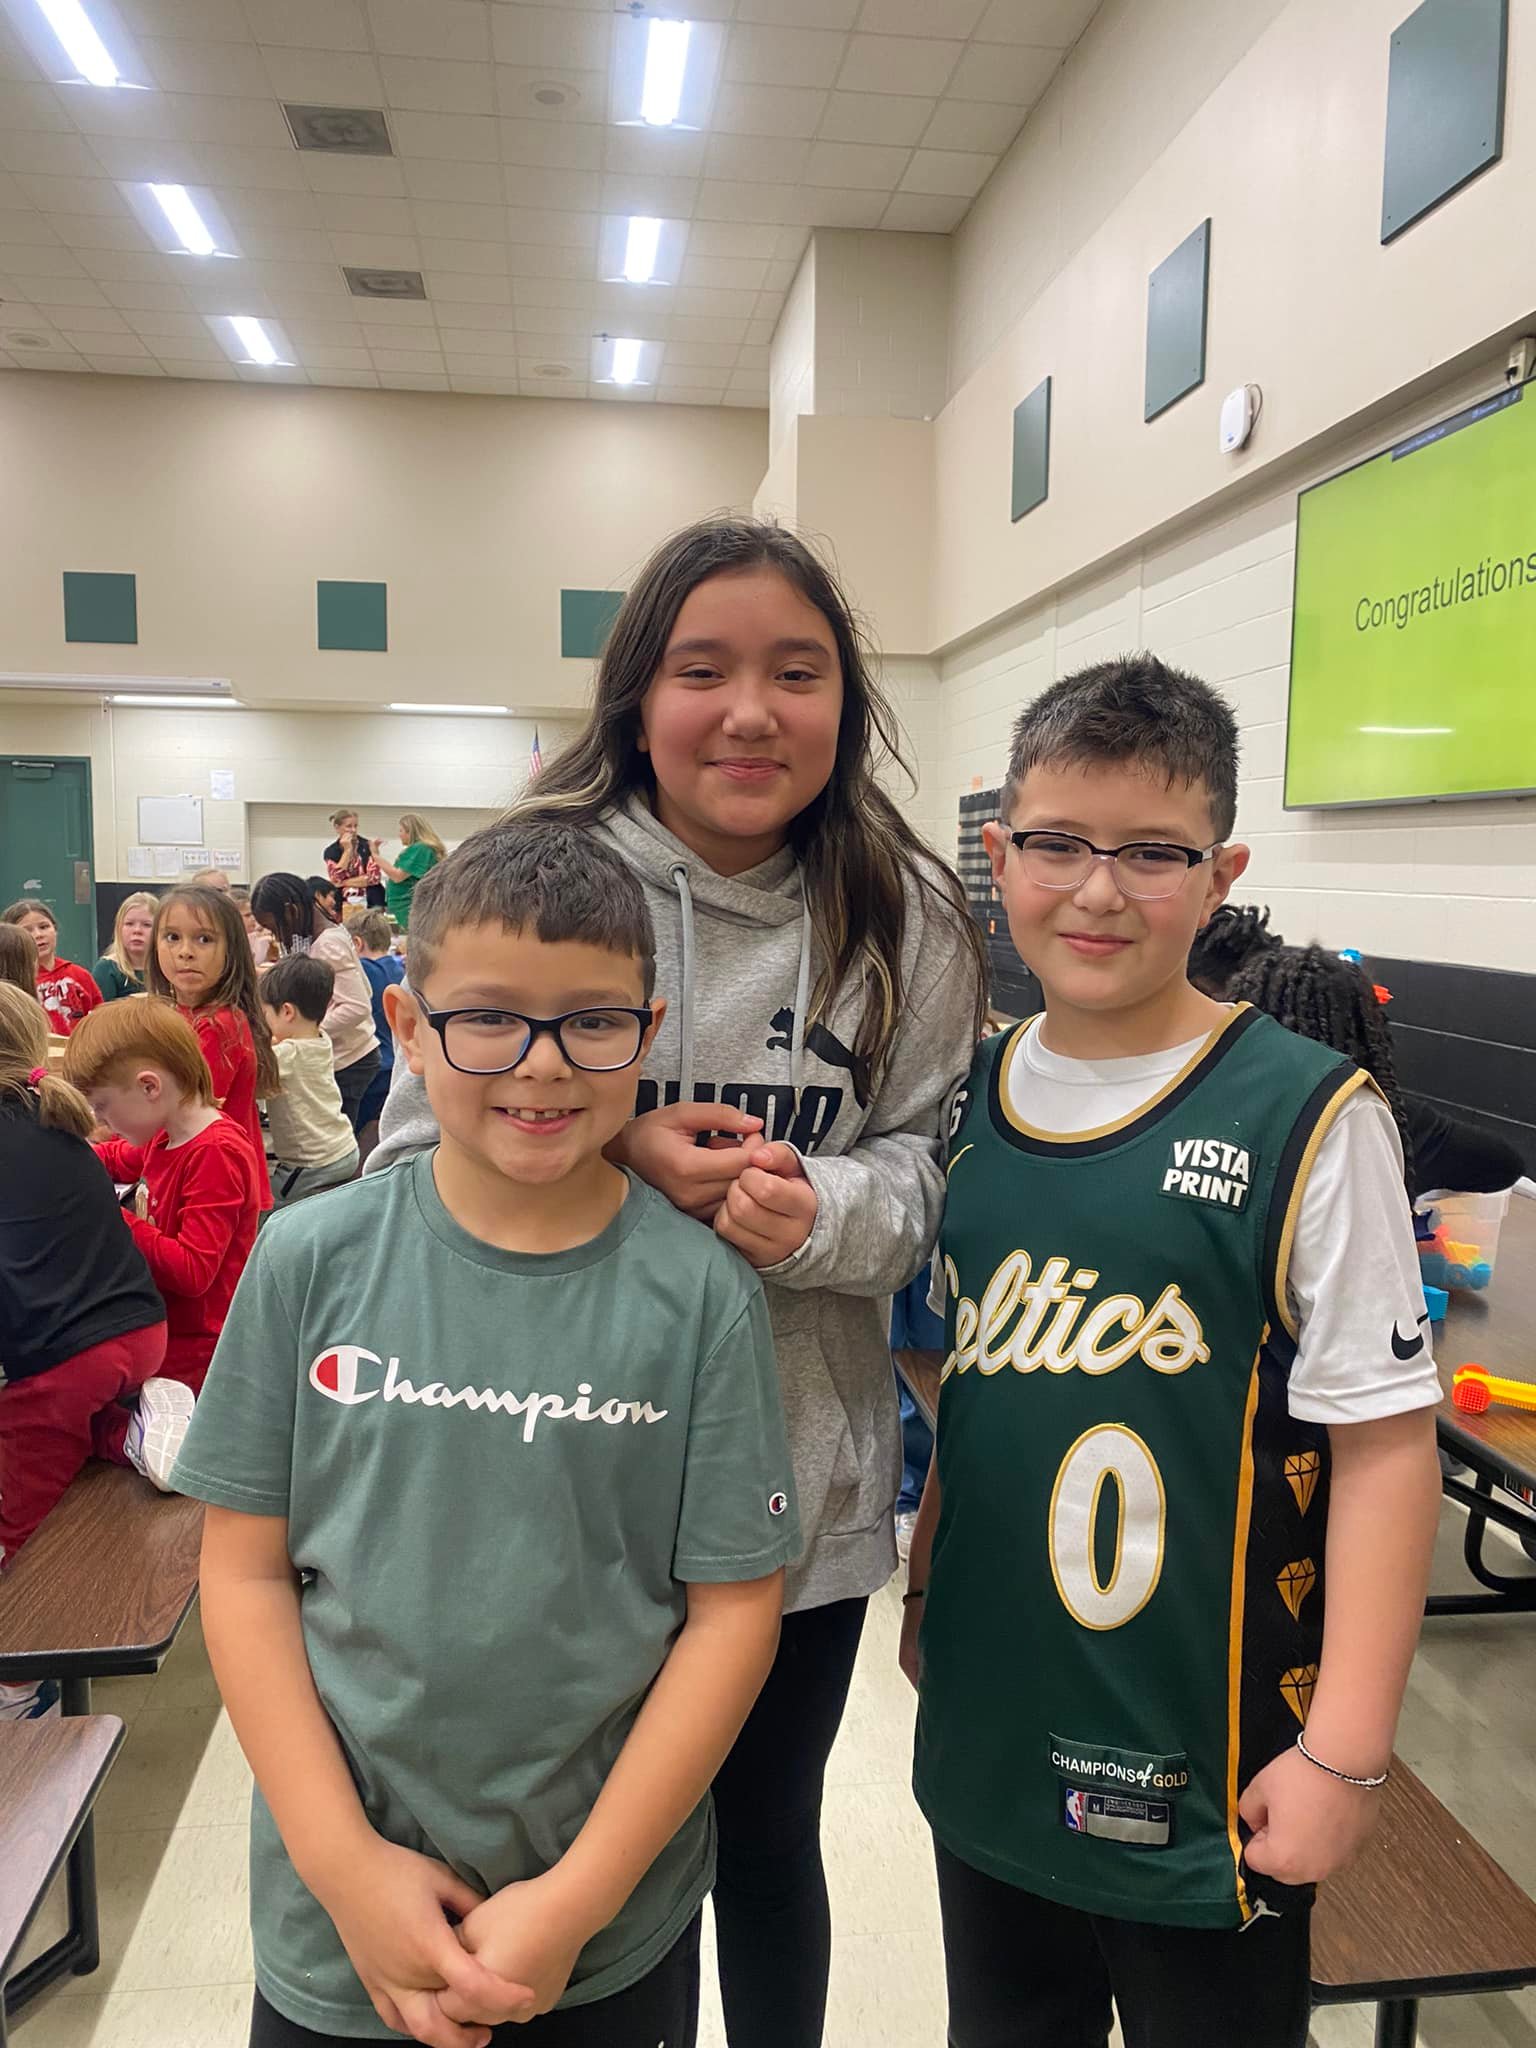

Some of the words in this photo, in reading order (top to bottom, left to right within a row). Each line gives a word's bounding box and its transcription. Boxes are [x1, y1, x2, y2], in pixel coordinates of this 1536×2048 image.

[1355, 551, 1536, 632] Congratulations
[1162, 1168, 1248, 1207] PRINT
[1173, 1139, 1249, 1183] VISTA
[940, 1249, 1211, 1385] eltics
[309, 1344, 668, 1443] Champion
[1048, 1422, 1167, 1631] 0
[1051, 1751, 1136, 1783] CHAMPIONS
[1153, 1772, 1188, 1787] GOLD
